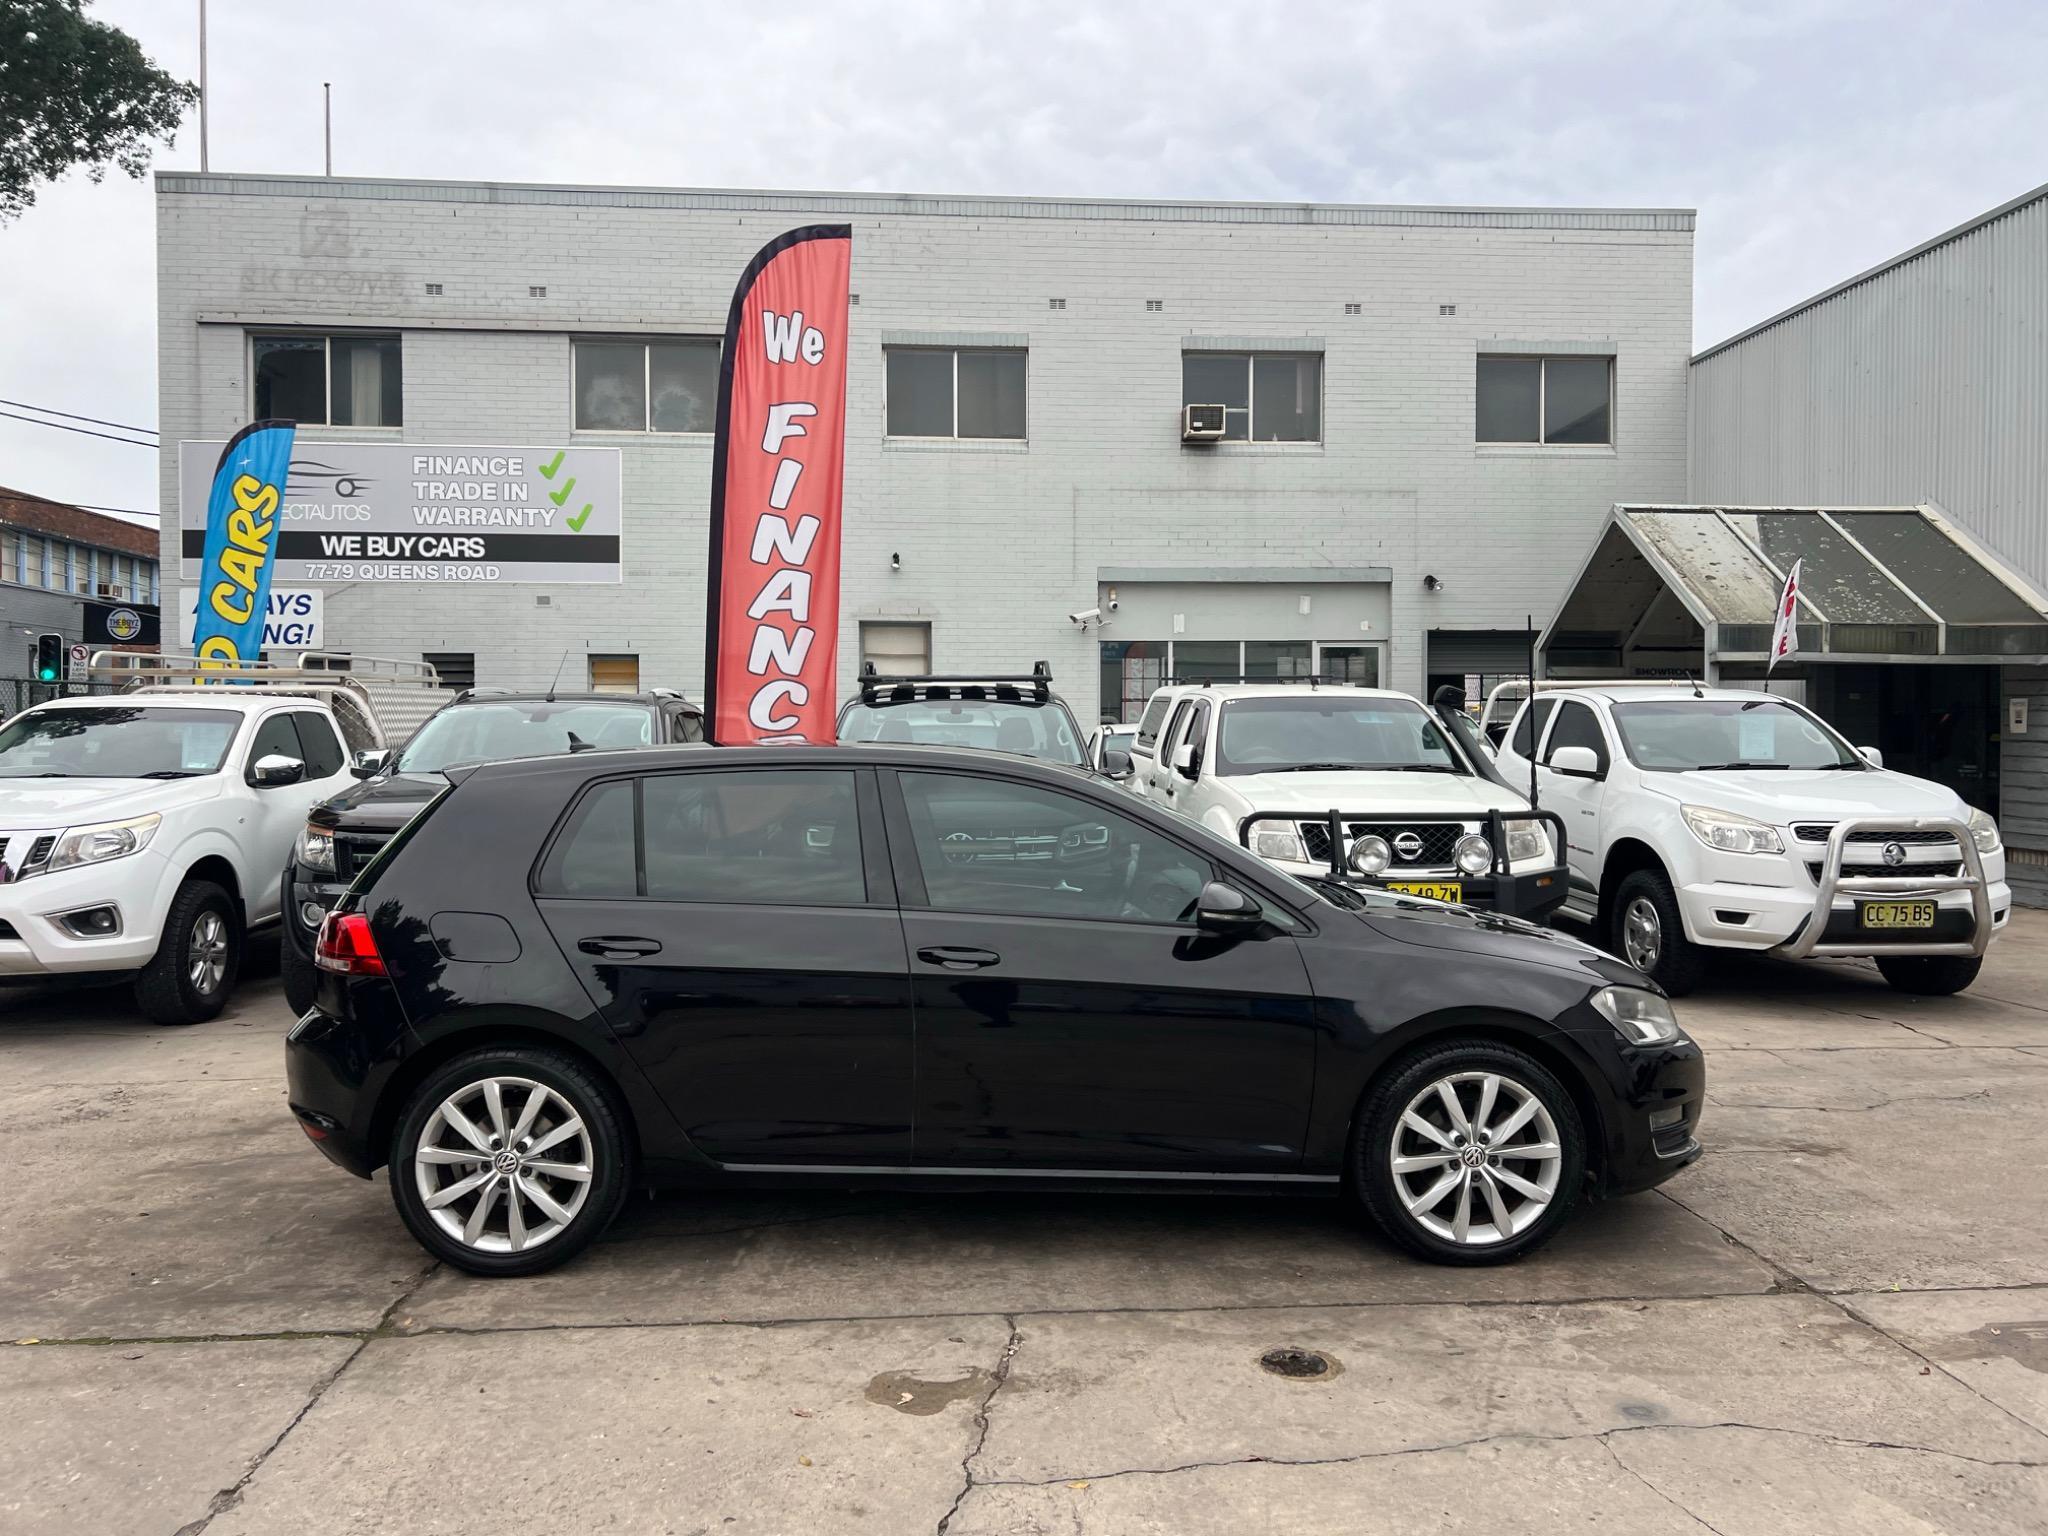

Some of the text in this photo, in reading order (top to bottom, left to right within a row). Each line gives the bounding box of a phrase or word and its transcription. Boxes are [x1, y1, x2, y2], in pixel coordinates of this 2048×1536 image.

[761, 309, 825, 366] We
[412, 456, 523, 476] FINANCE
[412, 481, 528, 501] TRADE IN
[281, 504, 372, 521] ECTAUTOS
[412, 506, 557, 527] WARRANTY
[210, 473, 280, 625] CARS
[320, 535, 486, 559] WE BUY CARS
[305, 563, 501, 581] 77-79 QUEENS ROAD
[747, 402, 820, 745] FINANC
